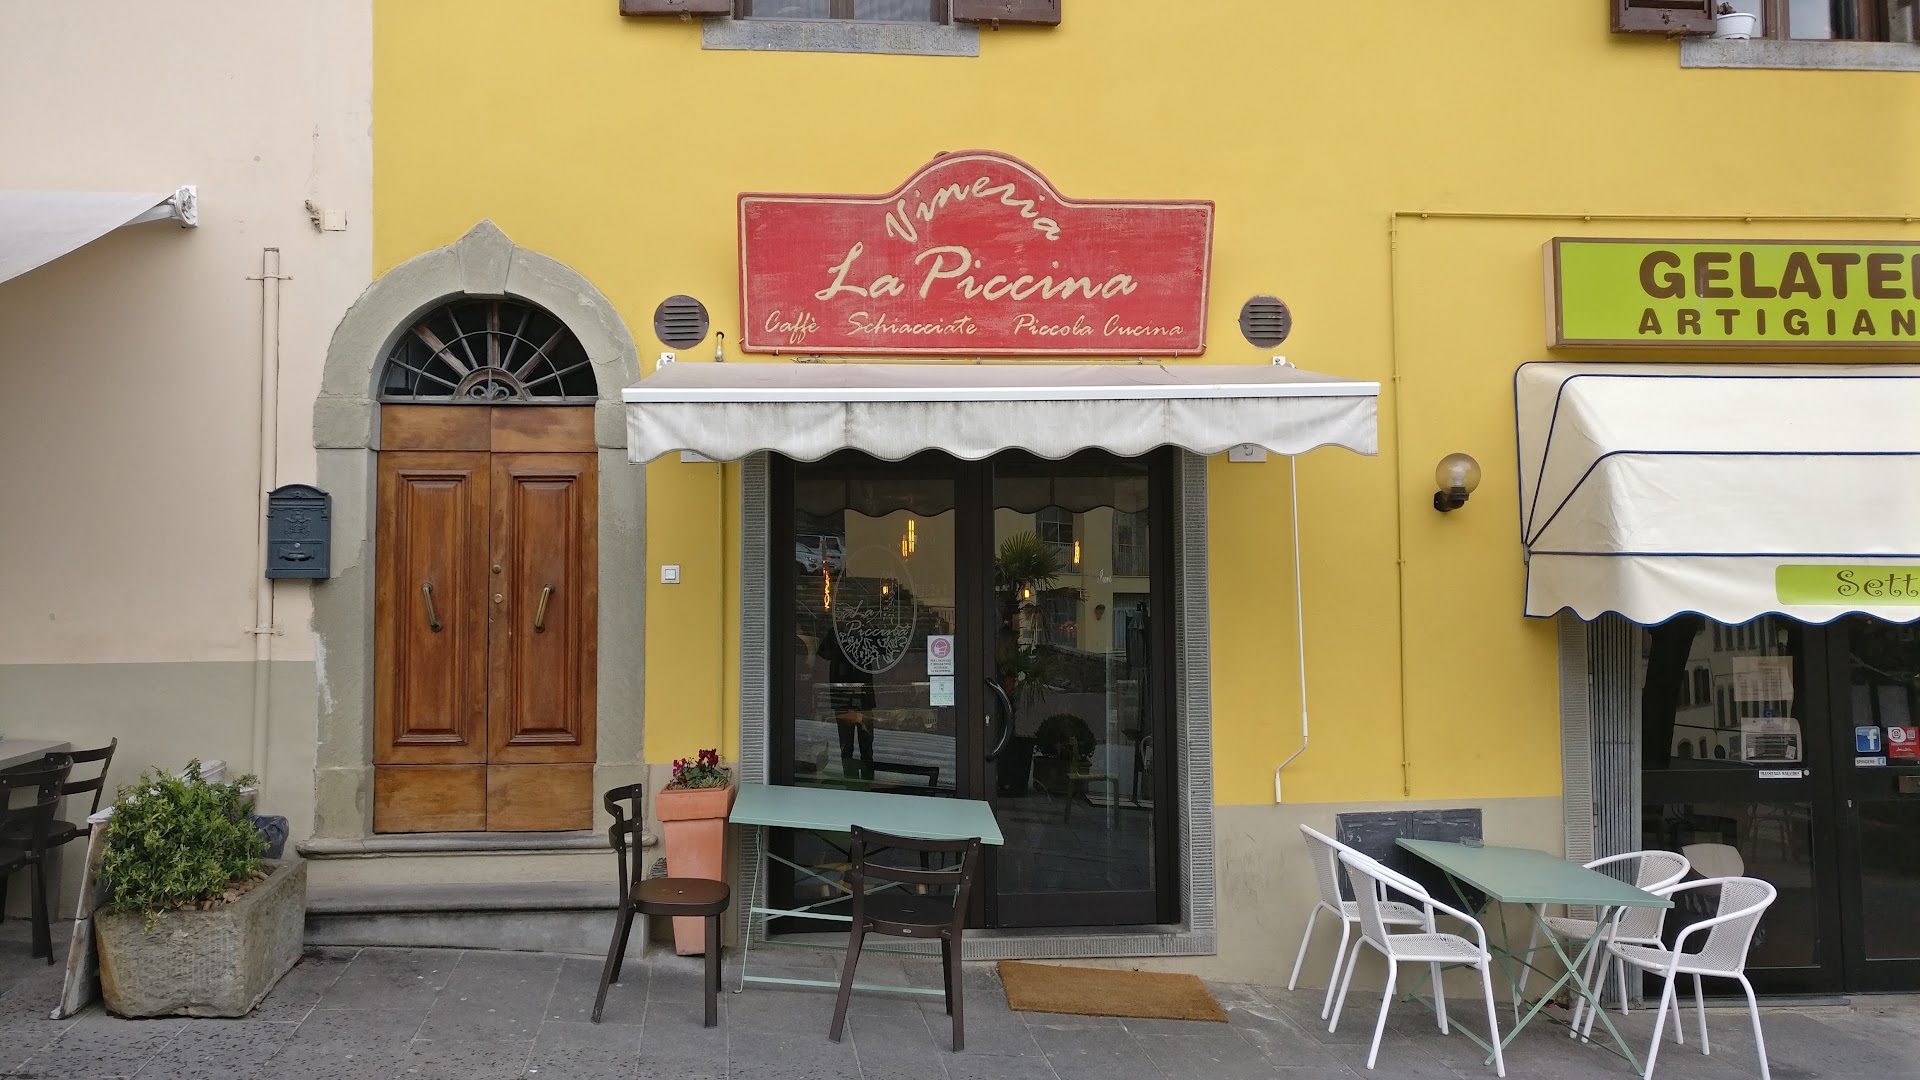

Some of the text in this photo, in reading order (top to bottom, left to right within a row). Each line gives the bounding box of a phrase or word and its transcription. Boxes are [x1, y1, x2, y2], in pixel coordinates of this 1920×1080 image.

[886, 176, 1060, 243] Vineria
[814, 241, 1138, 301] La Piccina
[1638, 250, 1920, 300] GELATE
[764, 309, 1184, 345] Caffè Schiacciate Piccola Cucina
[1638, 307, 1917, 337] ARTIGIAN
[1836, 569, 1919, 598] Sett
[851, 599, 876, 619] La
[845, 619, 909, 638] Piccina
